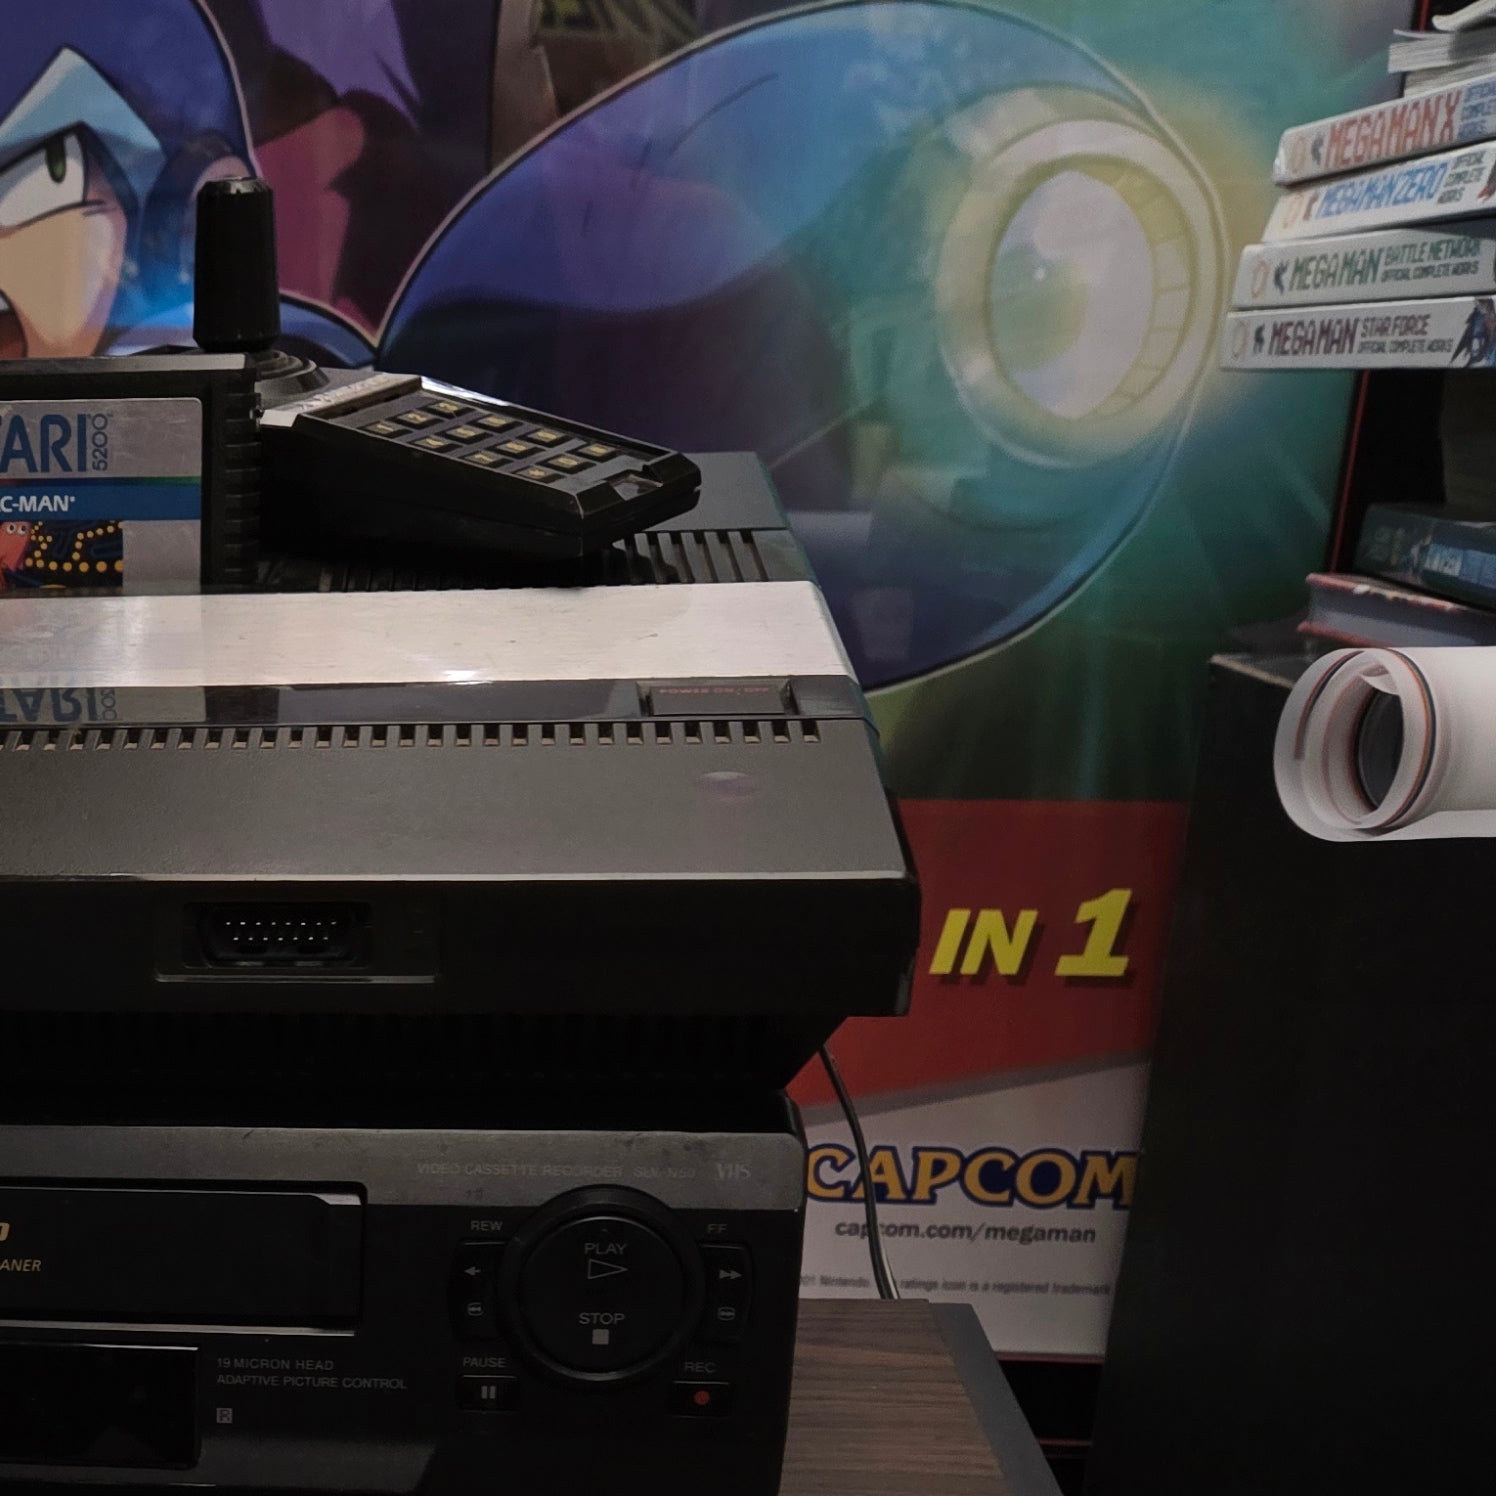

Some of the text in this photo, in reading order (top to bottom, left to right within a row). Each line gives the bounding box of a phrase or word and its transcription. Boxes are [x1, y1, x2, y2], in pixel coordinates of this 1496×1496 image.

[1289, 253, 1341, 292] MEGA
[1336, 247, 1384, 286] MAN
[1268, 320, 1317, 356] MEGA
[1316, 317, 1360, 356] MAN
[91, 412, 109, 472] 5200
[928, 888, 1134, 978] IN 1
[805, 1144, 1143, 1210] CAPCOM
[470, 1220, 503, 1231] REW
[707, 1223, 728, 1234] FF
[584, 1243, 629, 1256] PLAY
[579, 1312, 626, 1326] STOP
[216, 1358, 335, 1374] 19 MICRON HEAD
[463, 1356, 506, 1369] PAUSE
[683, 1361, 717, 1374] REC
[216, 1374, 408, 1391] ADAPTIVE PICTURE CONTROL
